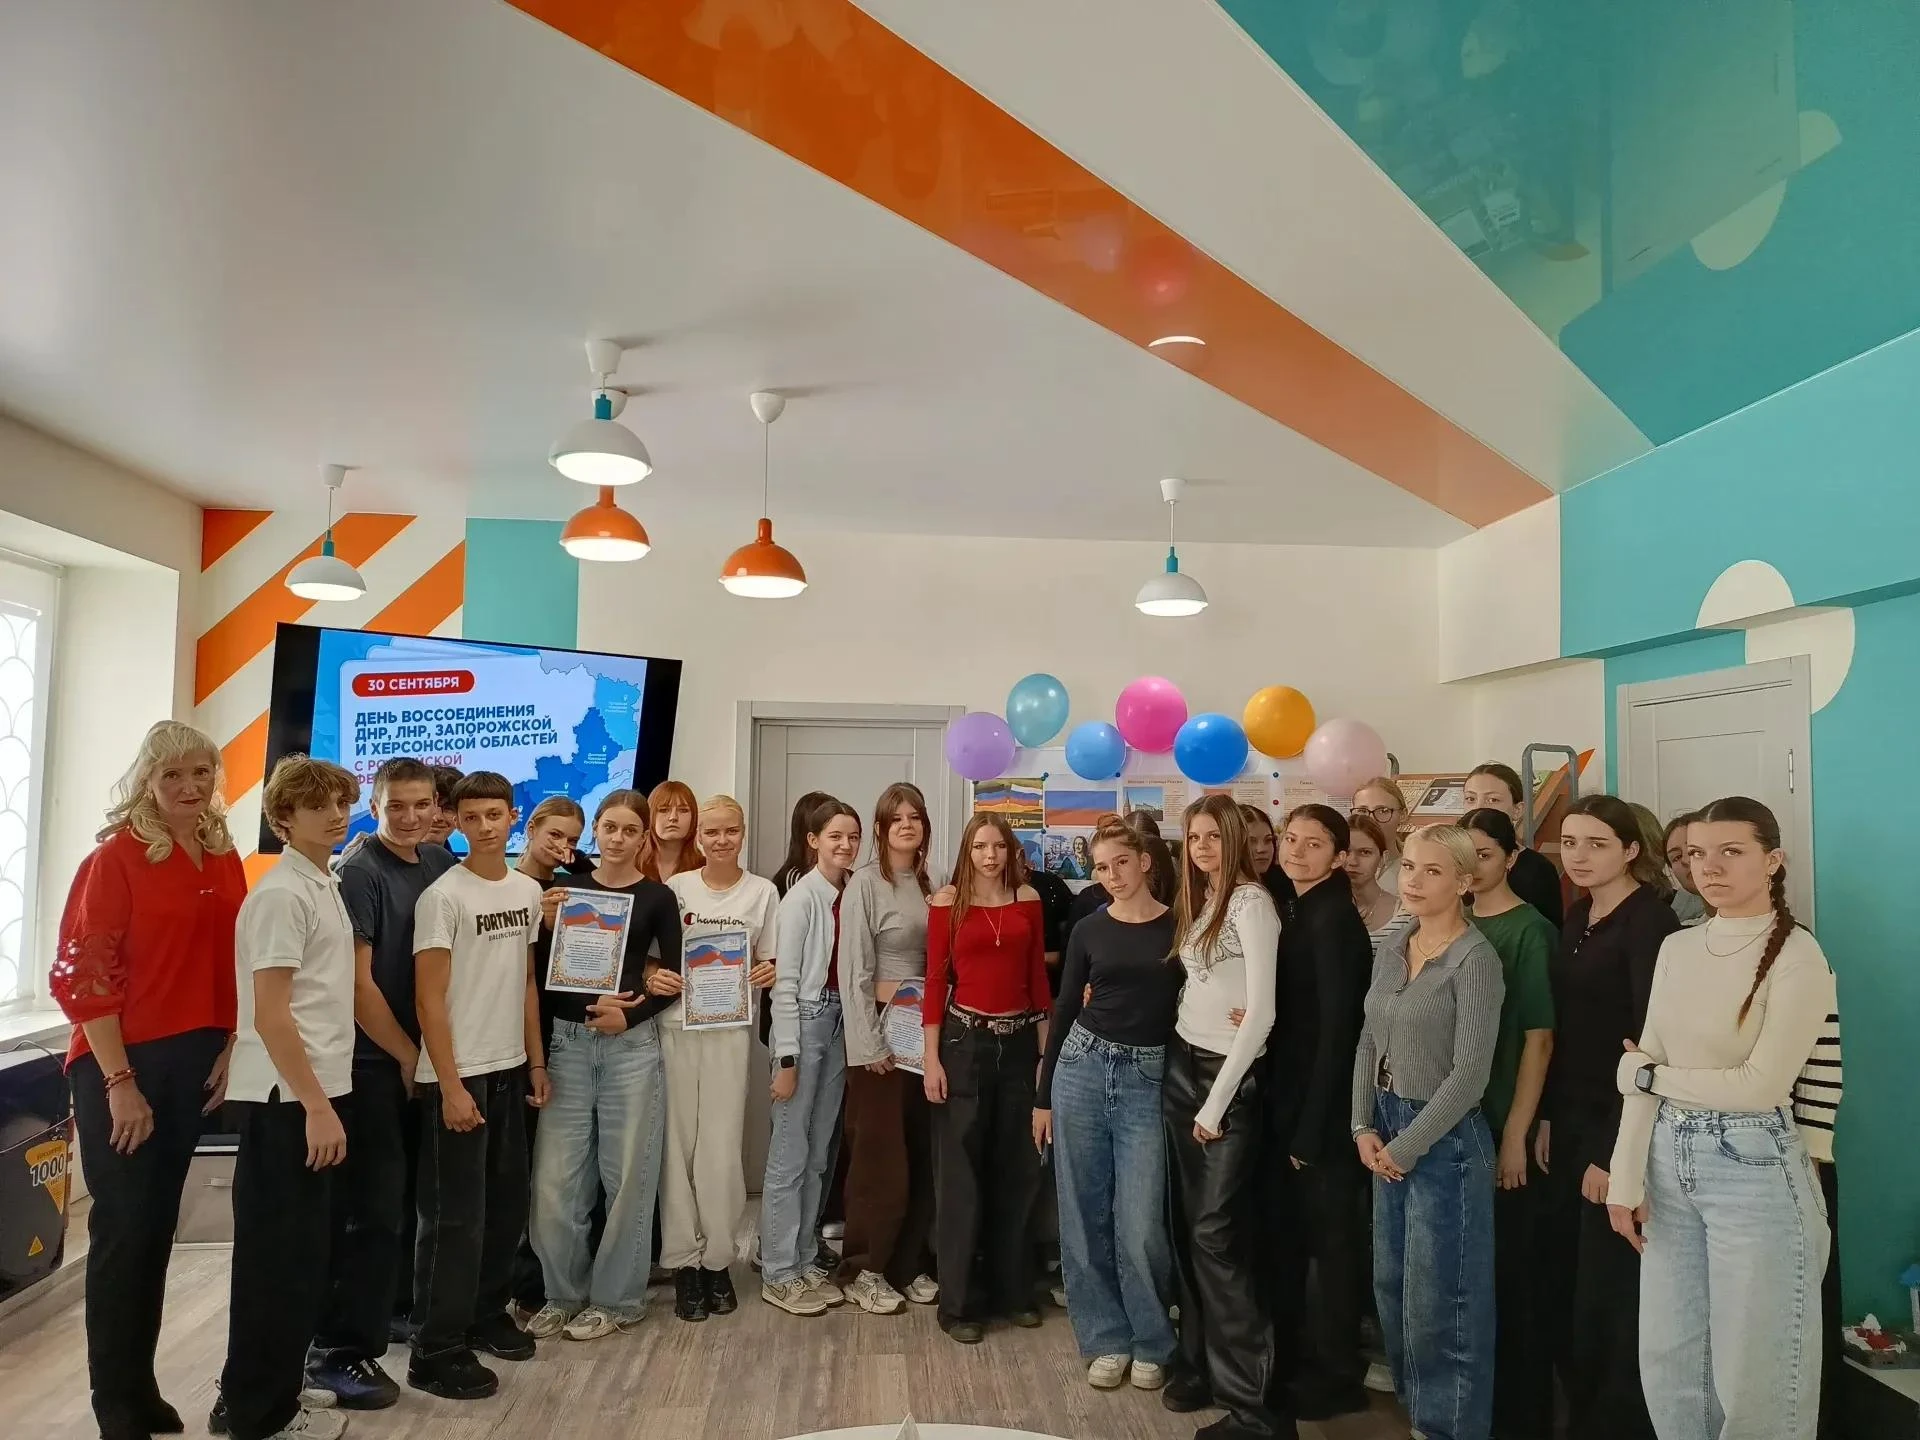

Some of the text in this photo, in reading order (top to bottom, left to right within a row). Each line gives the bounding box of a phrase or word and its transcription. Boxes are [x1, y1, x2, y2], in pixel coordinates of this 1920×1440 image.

[367, 676, 460, 691] 30 СЕНТЯБРЯ
[355, 704, 535, 727] ДЕНЬ ВОССОЕДИНЕНИЯ
[355, 715, 552, 743] ДНР, ЛНР, ЗАПОРОЖСКОЙ
[355, 729, 558, 756] И ХЕРСОНСКОЙ ОБЛАСТЕЙ
[354, 760, 363, 771] С
[476, 907, 529, 936] FORTNITE
[684, 912, 745, 931] Champion
[31, 1153, 65, 1187] 1000
